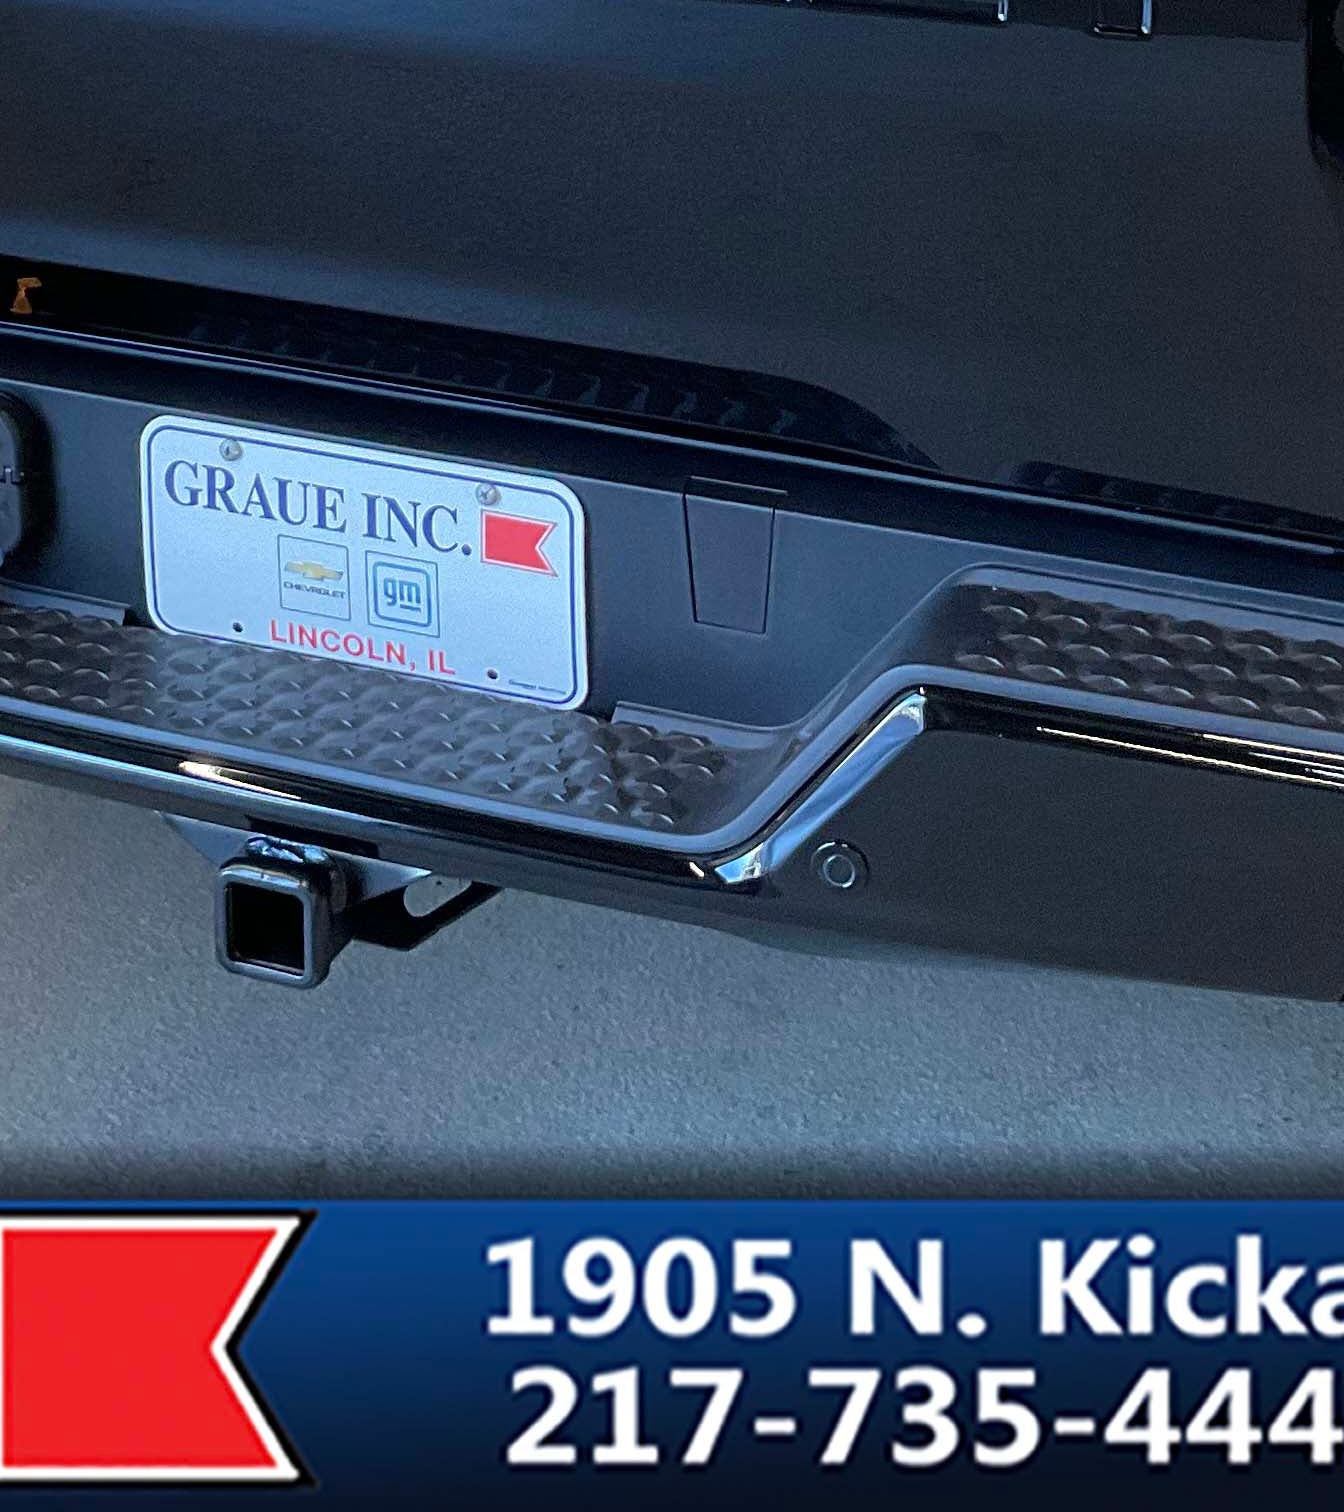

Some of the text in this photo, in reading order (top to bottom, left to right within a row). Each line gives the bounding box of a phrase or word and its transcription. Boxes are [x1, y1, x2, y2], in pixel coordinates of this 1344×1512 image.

[164, 459, 473, 556] GRAUE INC.
[283, 580, 347, 600] CHEVROLET
[383, 577, 422, 611] gm
[270, 618, 457, 676] LINCOLN, IL
